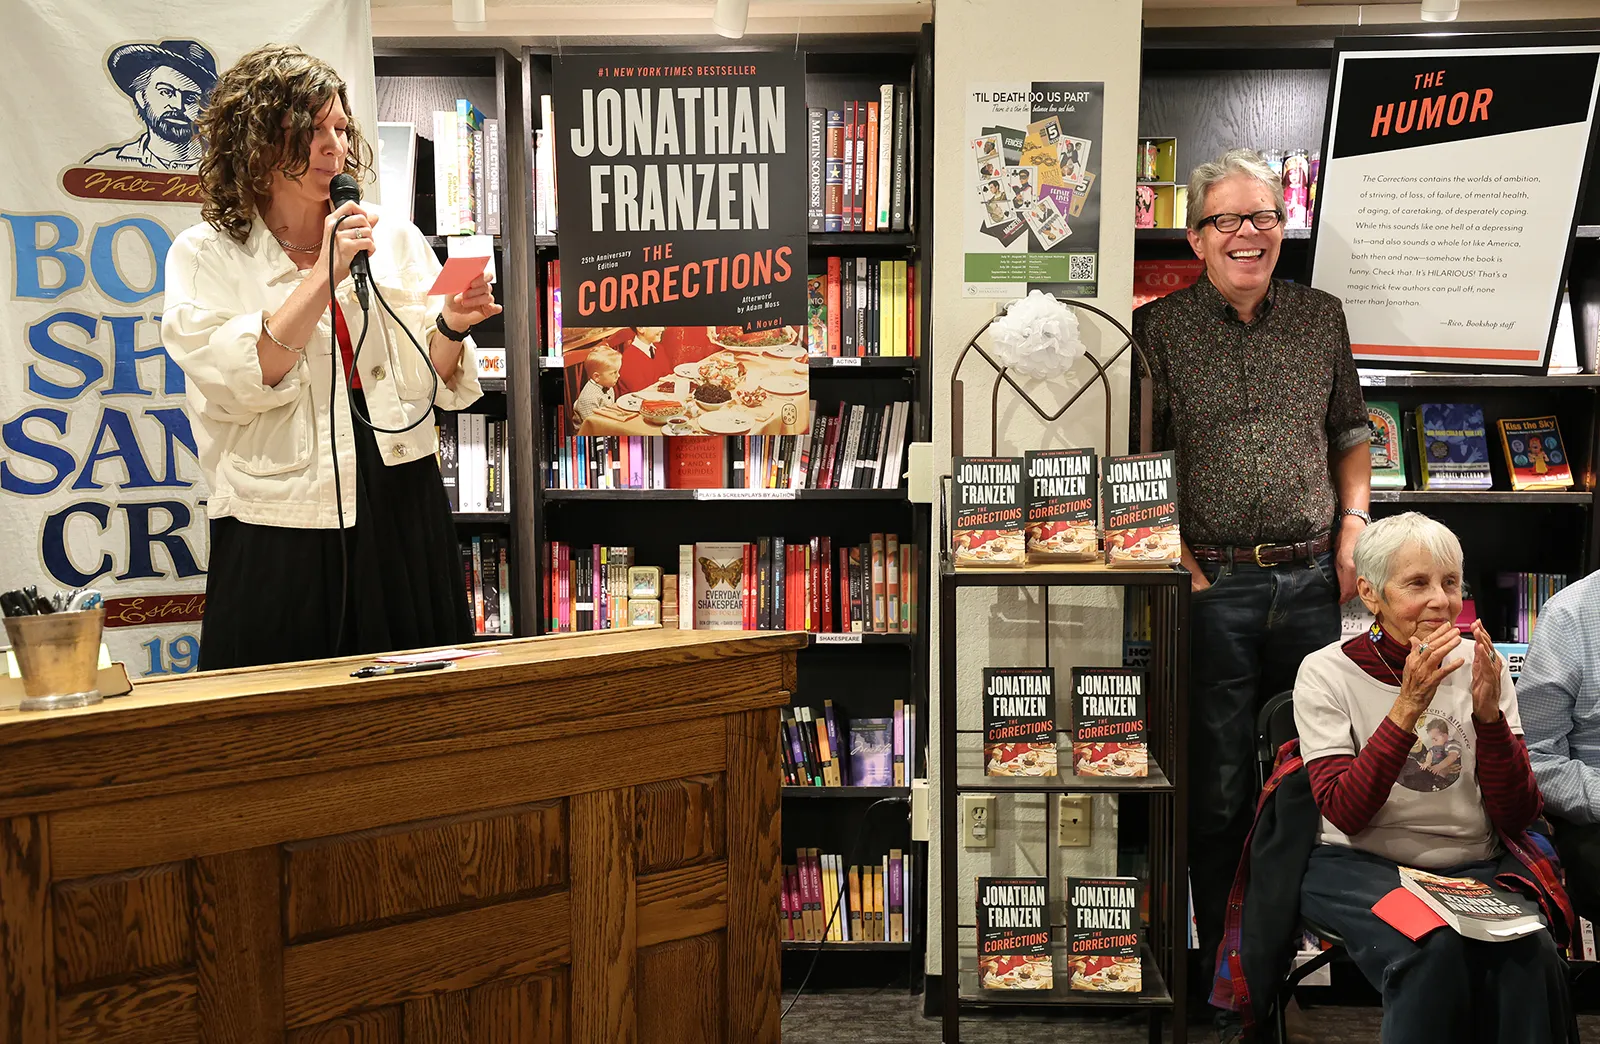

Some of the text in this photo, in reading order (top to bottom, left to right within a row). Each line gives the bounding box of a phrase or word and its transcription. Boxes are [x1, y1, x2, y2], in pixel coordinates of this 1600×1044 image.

[598, 65, 757, 77] #1 NEW YORK TIMES BESTSELLER
[1414, 70, 1446, 90] THE
[993, 92, 1026, 102] DEATH
[1028, 92, 1044, 102] DO
[1047, 91, 1061, 102] US
[1064, 91, 1090, 102] PART
[570, 86, 786, 157] JONATHAN
[1370, 88, 1493, 138] HUMOR
[474, 134, 483, 180] PARASITE
[489, 124, 498, 191] REFLECTIONS
[811, 120, 821, 207] MARTIN SCORSESE
[1363, 174, 1376, 183] The
[1377, 174, 1418, 183] Corrections
[1453, 175, 1466, 183] the
[1467, 175, 1493, 183] worlds
[1493, 174, 1503, 183] of
[590, 163, 769, 231] FRANZEN
[1359, 190, 1368, 199] of
[1399, 191, 1408, 199] of
[1427, 191, 1436, 199] of
[1464, 191, 1473, 199] of
[1473, 191, 1502, 199] mental
[1357, 206, 1366, 214] of
[1392, 206, 1401, 215] of
[1444, 207, 1454, 215] of
[1454, 207, 1499, 217] desperately
[1355, 222, 1377, 230] While
[1378, 222, 1392, 230] this
[1420, 223, 1434, 231] like
[1450, 223, 1465, 231] hell
[1465, 223, 1474, 231] of
[1481, 224, 1524, 234] depressing
[643, 243, 673, 262] THE
[1385, 238, 1402, 246] also
[1403, 238, 1429, 246] sounds
[1437, 239, 1460, 247] whole
[1461, 239, 1471, 247] lot
[1472, 239, 1486, 247] like
[0, 213, 171, 303] BO
[581, 250, 632, 264] 25th Anniversary
[597, 261, 619, 271] Edition
[1351, 252, 1369, 260] both
[1370, 253, 1387, 261] then
[1387, 253, 1403, 261] and
[1476, 255, 1495, 263] book
[578, 246, 792, 316] CORRECTIONS
[1372, 267, 1395, 276] Check
[742, 293, 772, 304] Afterword
[1347, 284, 1369, 292] magic
[1371, 283, 1386, 291] trick
[1388, 283, 1401, 291] few
[1402, 284, 1431, 292] authors
[1446, 285, 1462, 294] pull
[737, 300, 780, 314] by Adam Moss
[1345, 297, 1367, 305] better
[746, 317, 782, 331] A Novel
[1465, 319, 1498, 330] Bookshop
[1499, 321, 1515, 331] staff
[28, 311, 186, 399] SH
[479, 356, 504, 371] MOVIES
[1505, 420, 1554, 430] Kiss the Sky
[0, 407, 199, 495] SAN
[957, 464, 1020, 484] JONATHAN
[1028, 455, 1091, 478] JONATHAN
[1107, 461, 1172, 484] JONATHAN
[962, 485, 1015, 504] FRANZEN
[1033, 476, 1086, 497] FRANZEN
[1112, 481, 1168, 504] FRANZEN
[957, 508, 1022, 528] CORRECTIONS
[1029, 498, 1092, 520] CORRECTIONS
[1109, 502, 1175, 528] CORRECTIONS
[42, 501, 208, 587] CR
[697, 600, 743, 610] SHAKESPEAR
[705, 590, 741, 600] EVERYDAY
[108, 596, 206, 623] Establ
[143, 635, 200, 675] 19
[987, 675, 1051, 696] JONATHAN
[1076, 675, 1141, 696] JONATHAN
[993, 697, 1046, 717] FRANZEN
[1082, 697, 1136, 717] FRANZEN
[989, 720, 1053, 740] CORRECTIONS
[1078, 720, 1143, 740] CORRECTIONS
[982, 886, 1046, 906] JONATHAN
[1071, 886, 1135, 908] JONATHAN
[1424, 885, 1492, 896] CORRECTIONS
[1438, 892, 1507, 906] FRANZEN
[1444, 900, 1523, 914] JONATHAN
[988, 907, 1041, 928] FRANZEN
[1077, 908, 1131, 930] FRANZEN
[984, 932, 1048, 953] CORRECTIONS
[1072, 933, 1137, 953] CORRECTIONS
